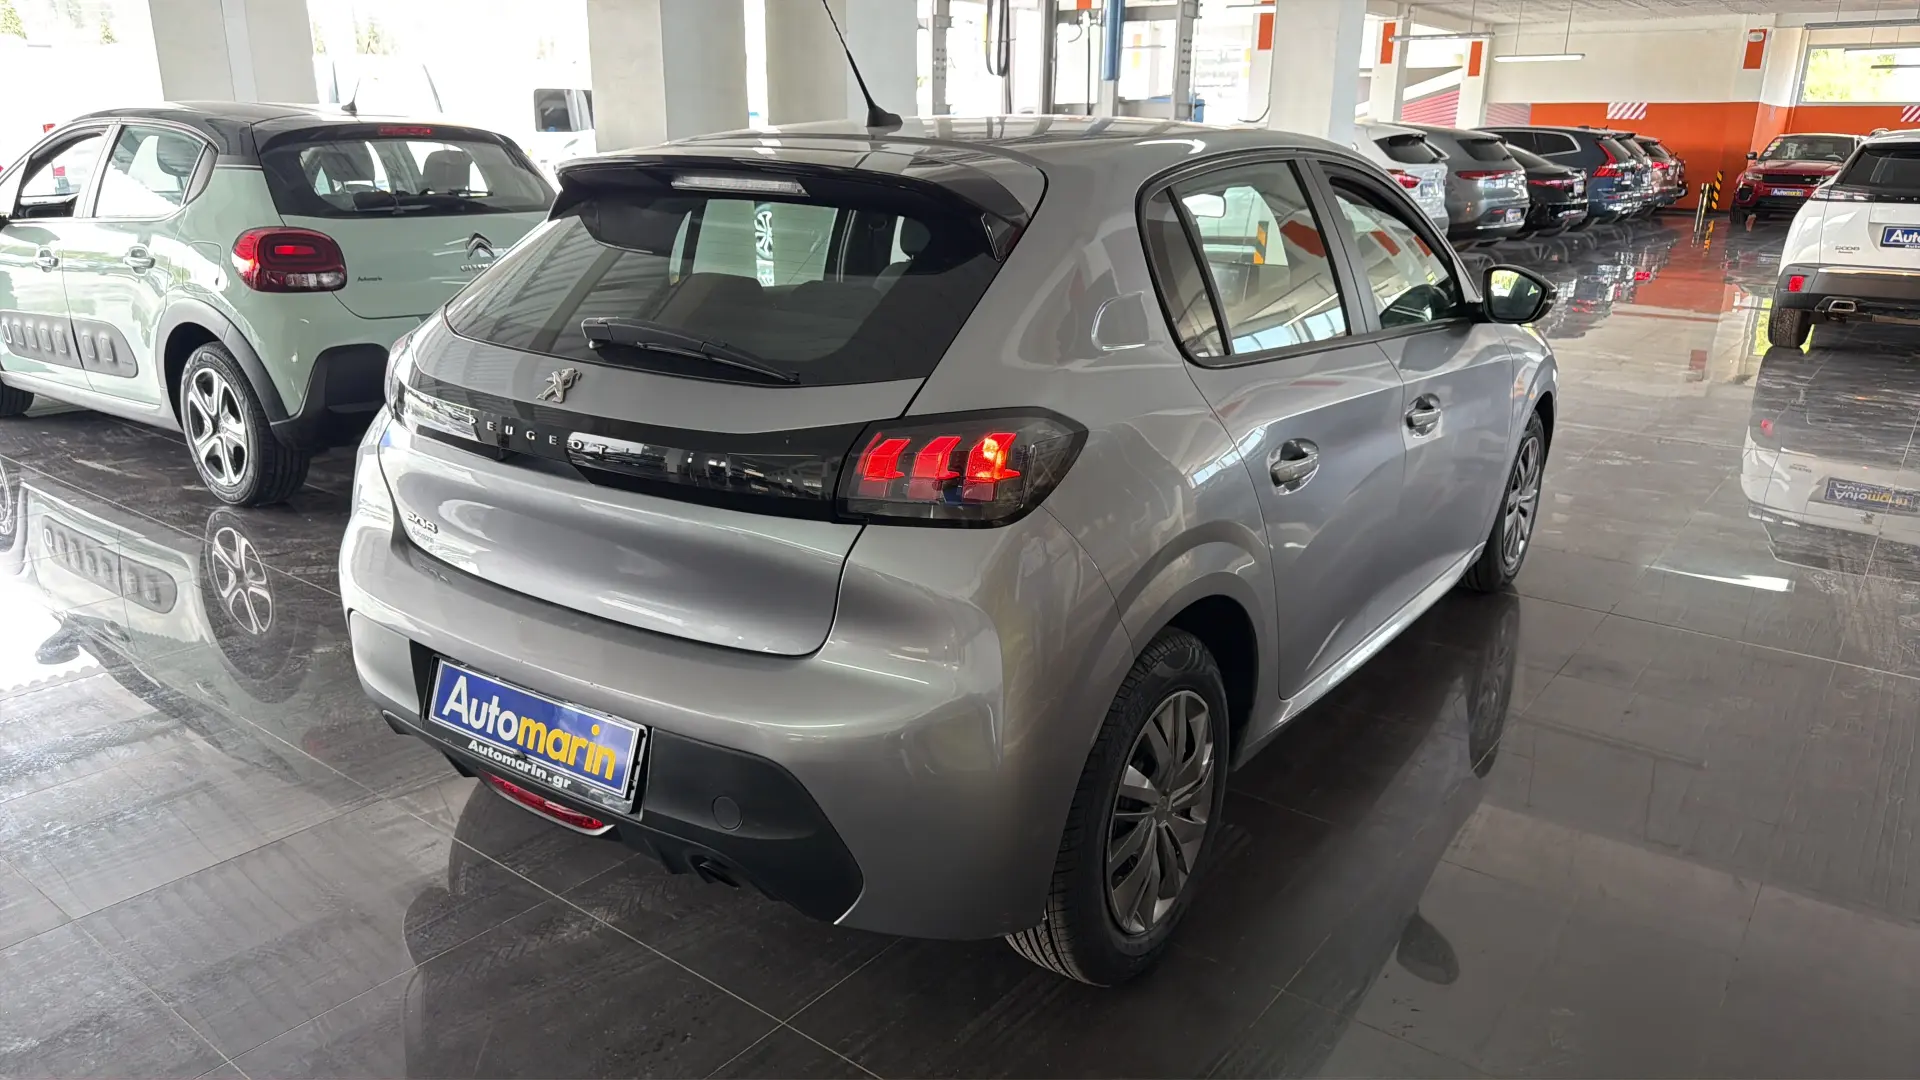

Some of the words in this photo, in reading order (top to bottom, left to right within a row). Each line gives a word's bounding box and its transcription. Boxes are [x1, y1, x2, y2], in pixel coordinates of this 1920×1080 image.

[469, 416, 608, 456] PEUGEOT
[441, 675, 616, 780] Automarin
[467, 739, 572, 789] Automarin.gr
